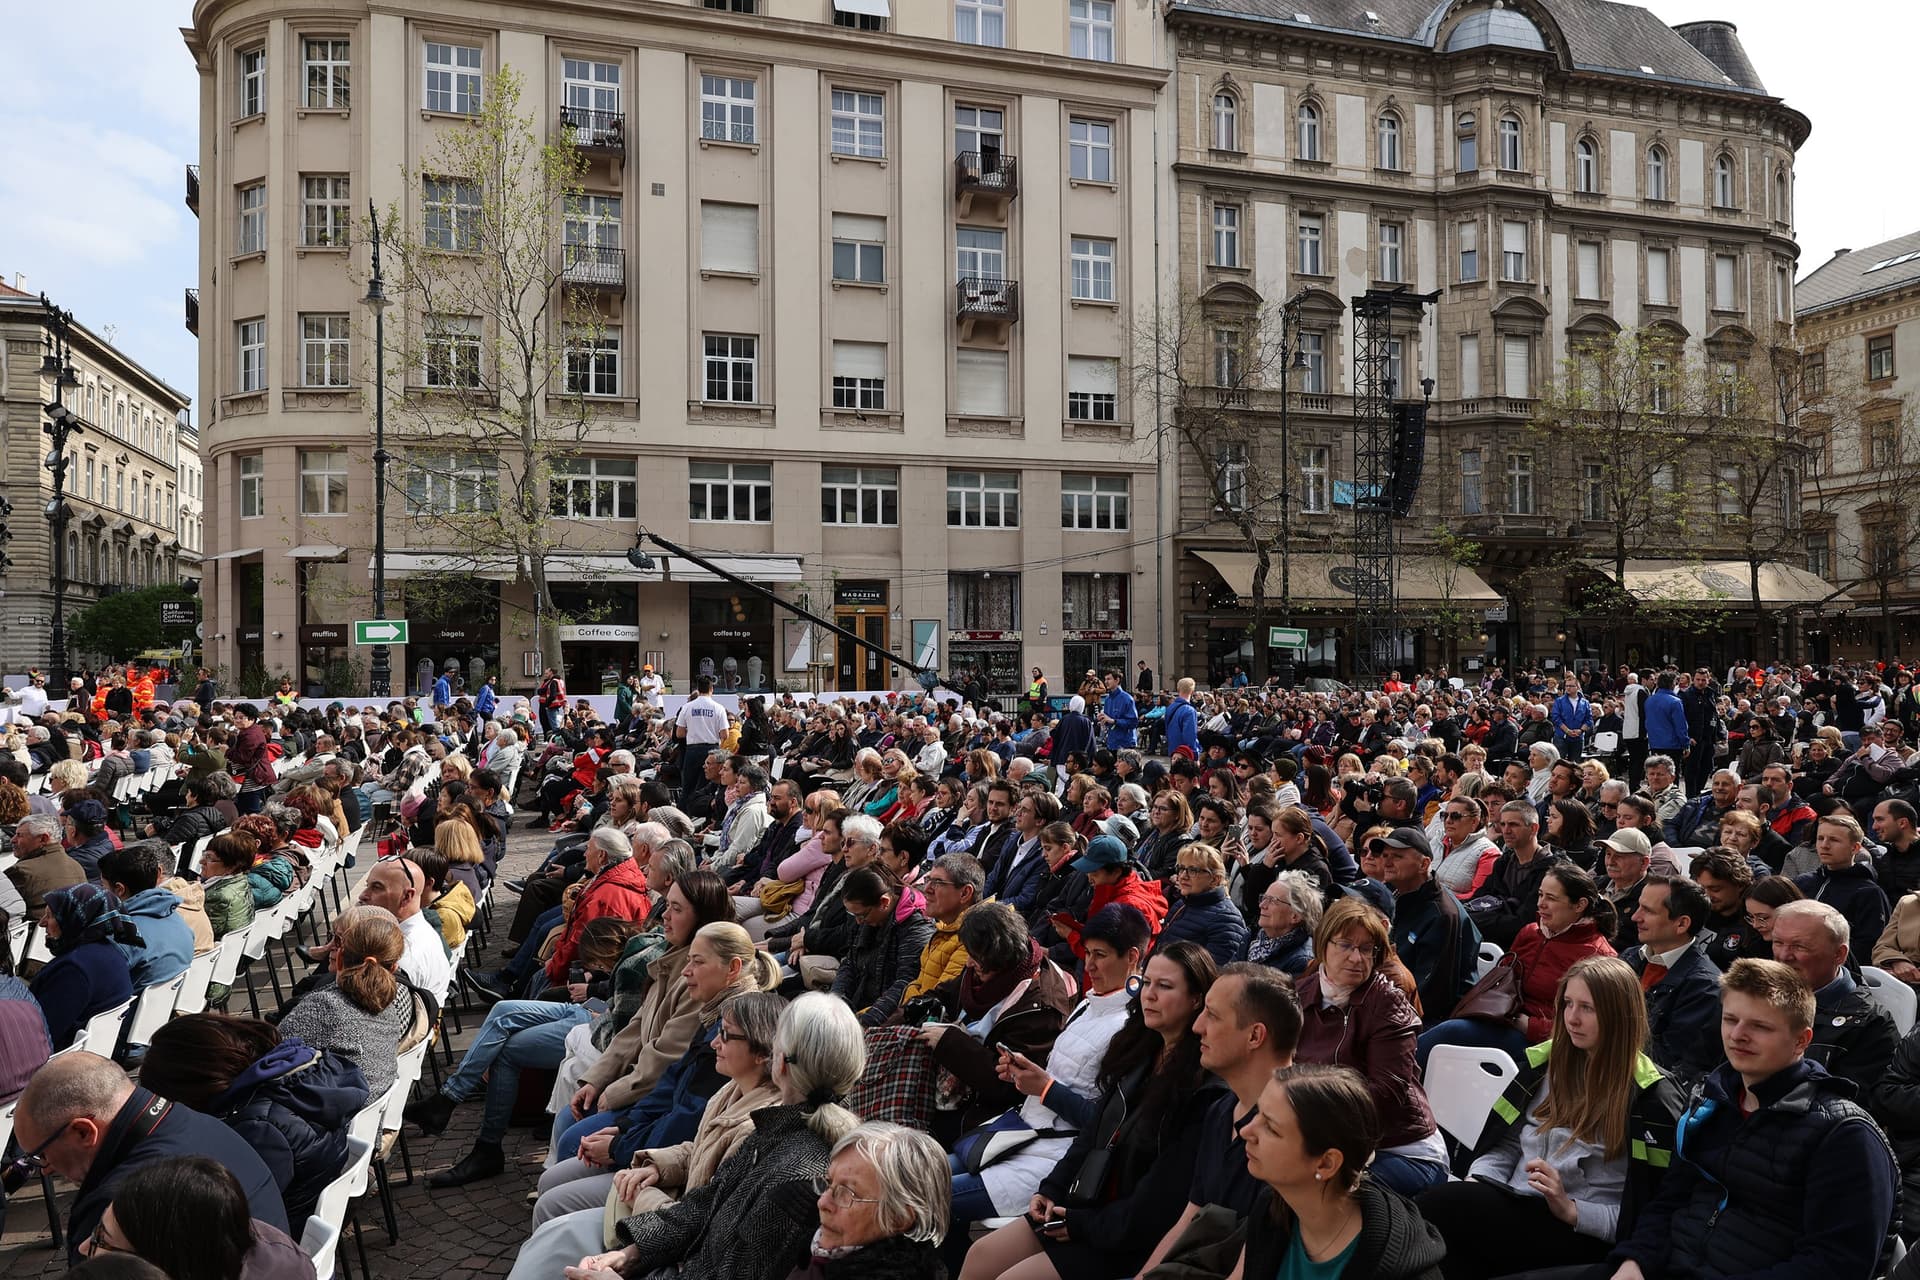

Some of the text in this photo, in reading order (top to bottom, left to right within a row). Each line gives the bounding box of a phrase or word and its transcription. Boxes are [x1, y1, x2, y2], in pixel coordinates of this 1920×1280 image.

[311, 630, 338, 638] muffins
[441, 630, 465, 638] bagels
[577, 628, 612, 637] Coffee
